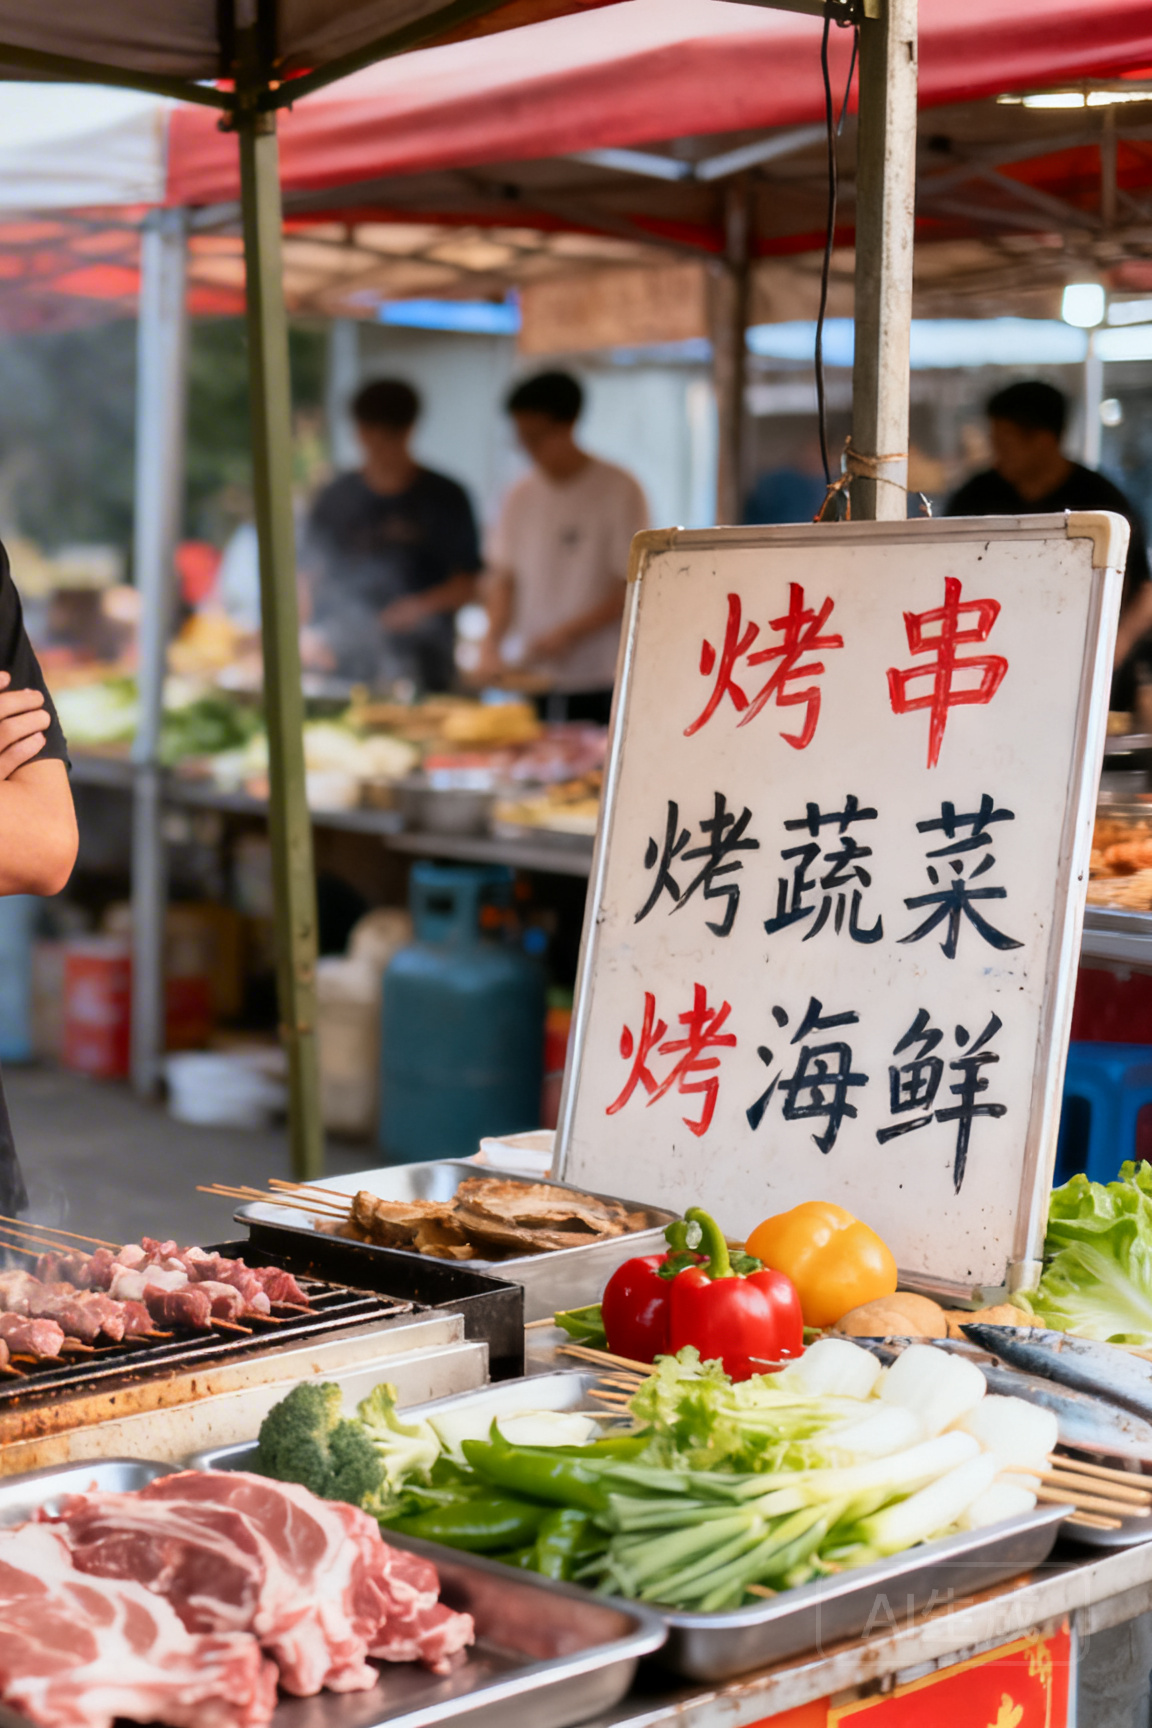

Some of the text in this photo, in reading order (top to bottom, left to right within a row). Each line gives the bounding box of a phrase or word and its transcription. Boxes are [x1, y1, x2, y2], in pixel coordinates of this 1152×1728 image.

[683, 576, 1009, 769] 烤串
[633, 792, 1026, 960] 烤蔬菜
[605, 982, 1008, 1195] 烤海鲜
